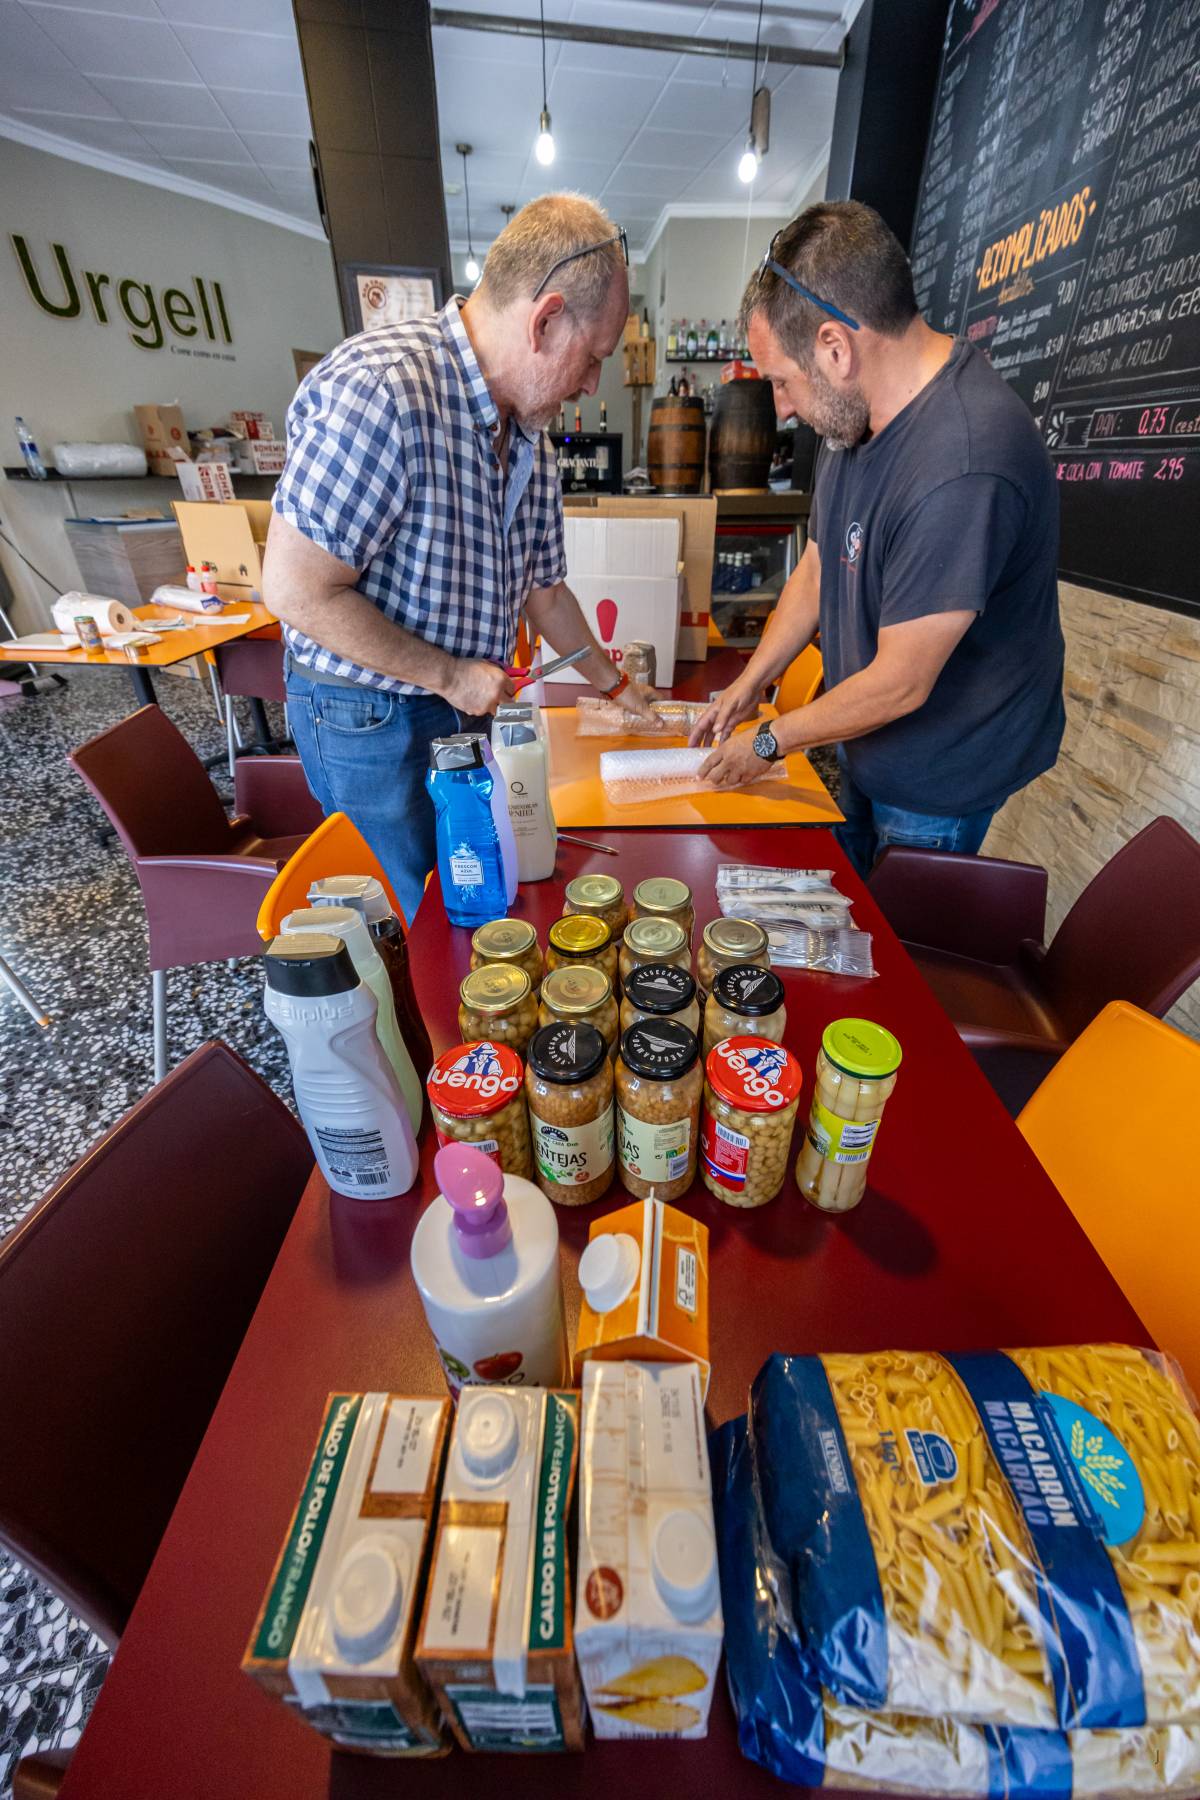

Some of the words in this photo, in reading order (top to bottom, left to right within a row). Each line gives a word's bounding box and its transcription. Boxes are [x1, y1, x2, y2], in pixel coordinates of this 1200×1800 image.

[1139, 224, 1177, 267] TORO
[10, 233, 233, 349] Urgell
[1108, 461, 1145, 479] TOMATE
[535, 1140, 587, 1168] ENTEJAS
[325, 1401, 350, 1457] CALDO
[319, 1460, 333, 1484] DE
[1008, 1401, 1078, 1528] MACARRÓN
[539, 1562, 556, 1640] CALDO
